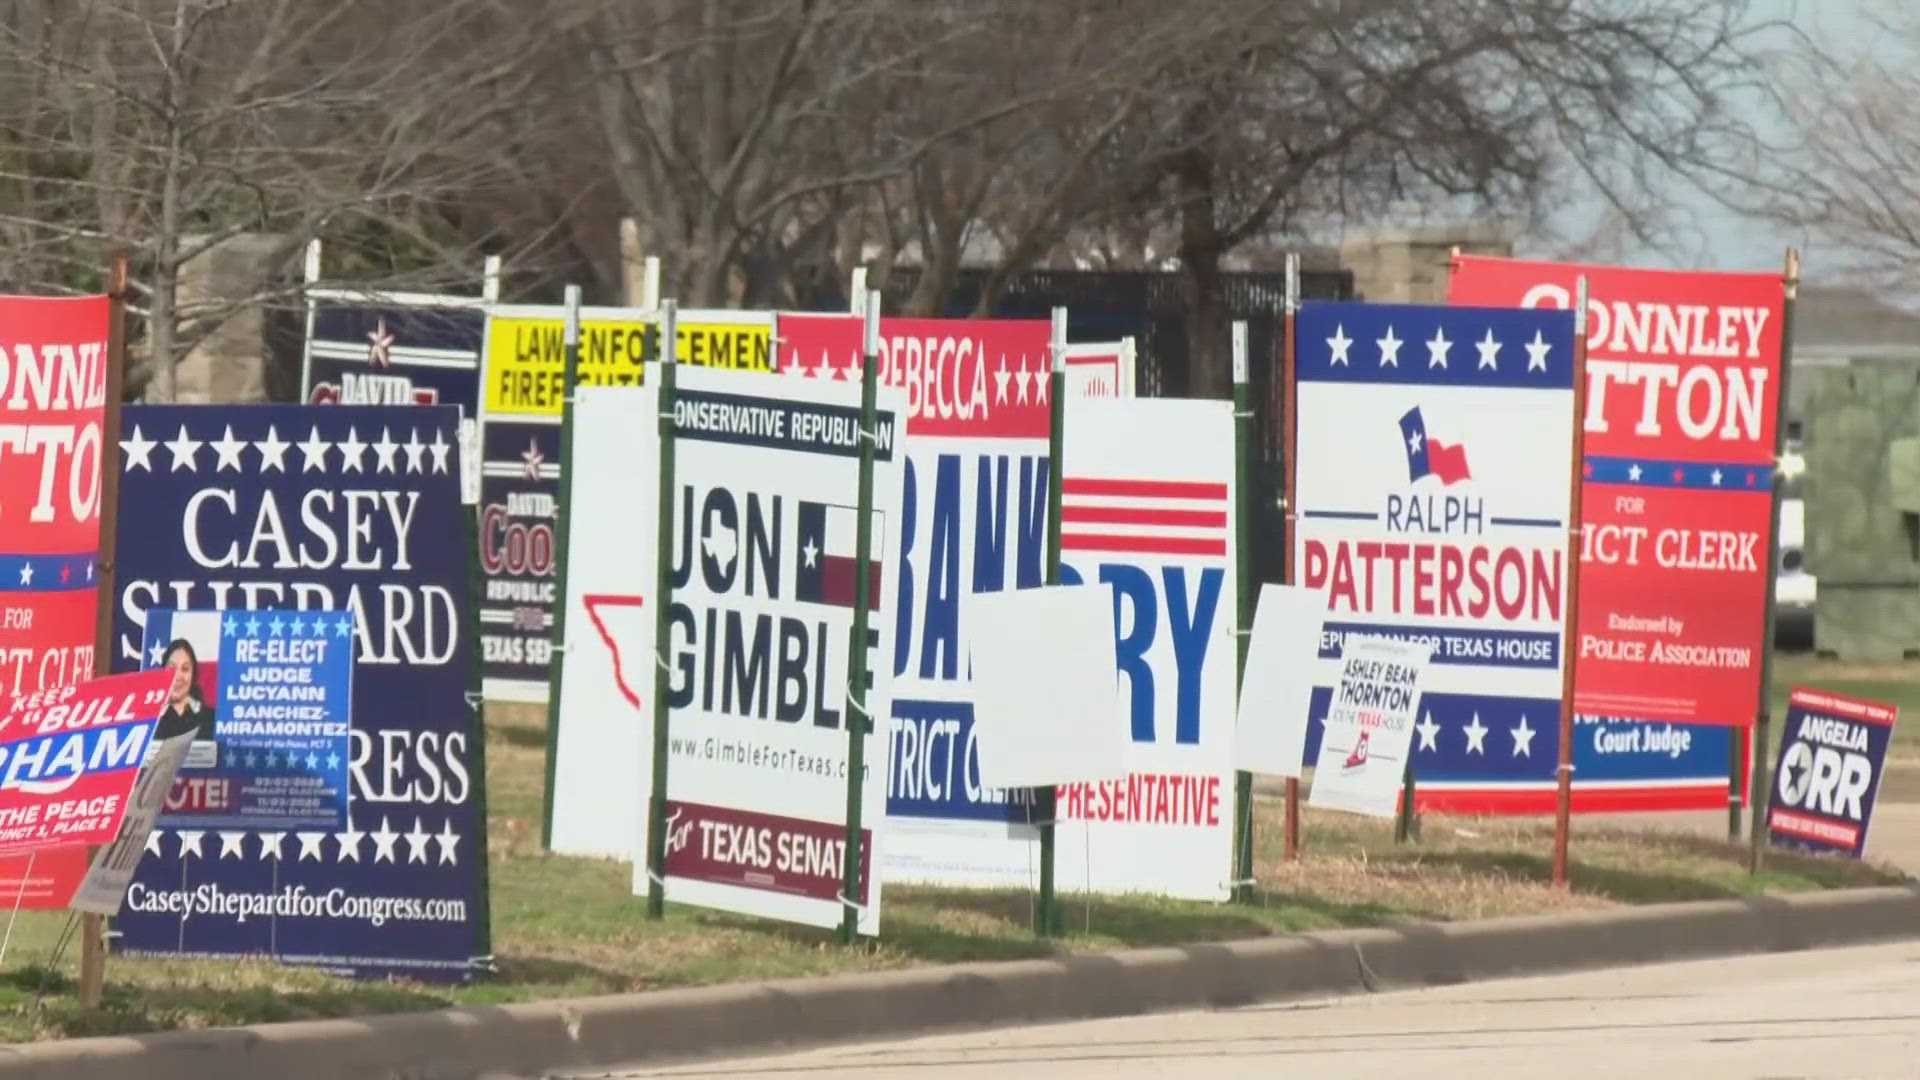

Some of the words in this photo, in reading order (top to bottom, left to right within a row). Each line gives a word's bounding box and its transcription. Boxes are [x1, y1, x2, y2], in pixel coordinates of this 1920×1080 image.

[516, 327, 564, 362] LAW
[576, 329, 771, 370] ENFOEMEN
[791, 411, 891, 451] REPUBLIN
[1387, 494, 1483, 535] RALPH
[1615, 496, 1646, 514] FOR
[183, 487, 420, 570] CASEY
[670, 482, 782, 601] JON
[1655, 528, 1759, 572] CLERK
[1304, 539, 1562, 622] PATTERSON
[4, 607, 33, 629] FOR
[1608, 613, 1667, 633] Endorsed
[1669, 616, 1683, 637] by
[235, 638, 328, 664] RE-ELECT
[1061, 563, 1225, 745] RY
[1444, 637, 1494, 658] TEXAS
[1496, 640, 1553, 661] HOUSE
[240, 667, 312, 683] JUDGE
[1344, 659, 1384, 681] ASHLEY
[1385, 663, 1418, 686] BEAN
[226, 684, 326, 701] LUCYANN
[1340, 680, 1413, 713] THORNTON
[216, 720, 347, 737] MIRAMONTEZ
[232, 705, 331, 721] SANCHEZ-
[1593, 726, 1641, 754] Court
[1642, 723, 1691, 759] Judge
[1797, 714, 1868, 753] ANGELIA
[1779, 741, 1872, 822] ORR
[44, 794, 120, 822] PEACE
[52, 818, 98, 835] PLACE
[98, 816, 112, 830] 2
[664, 806, 693, 858] For
[699, 819, 772, 869] TEXAS
[776, 831, 863, 885] SENAT
[127, 882, 466, 927] CaseyShepardforCongress.com
